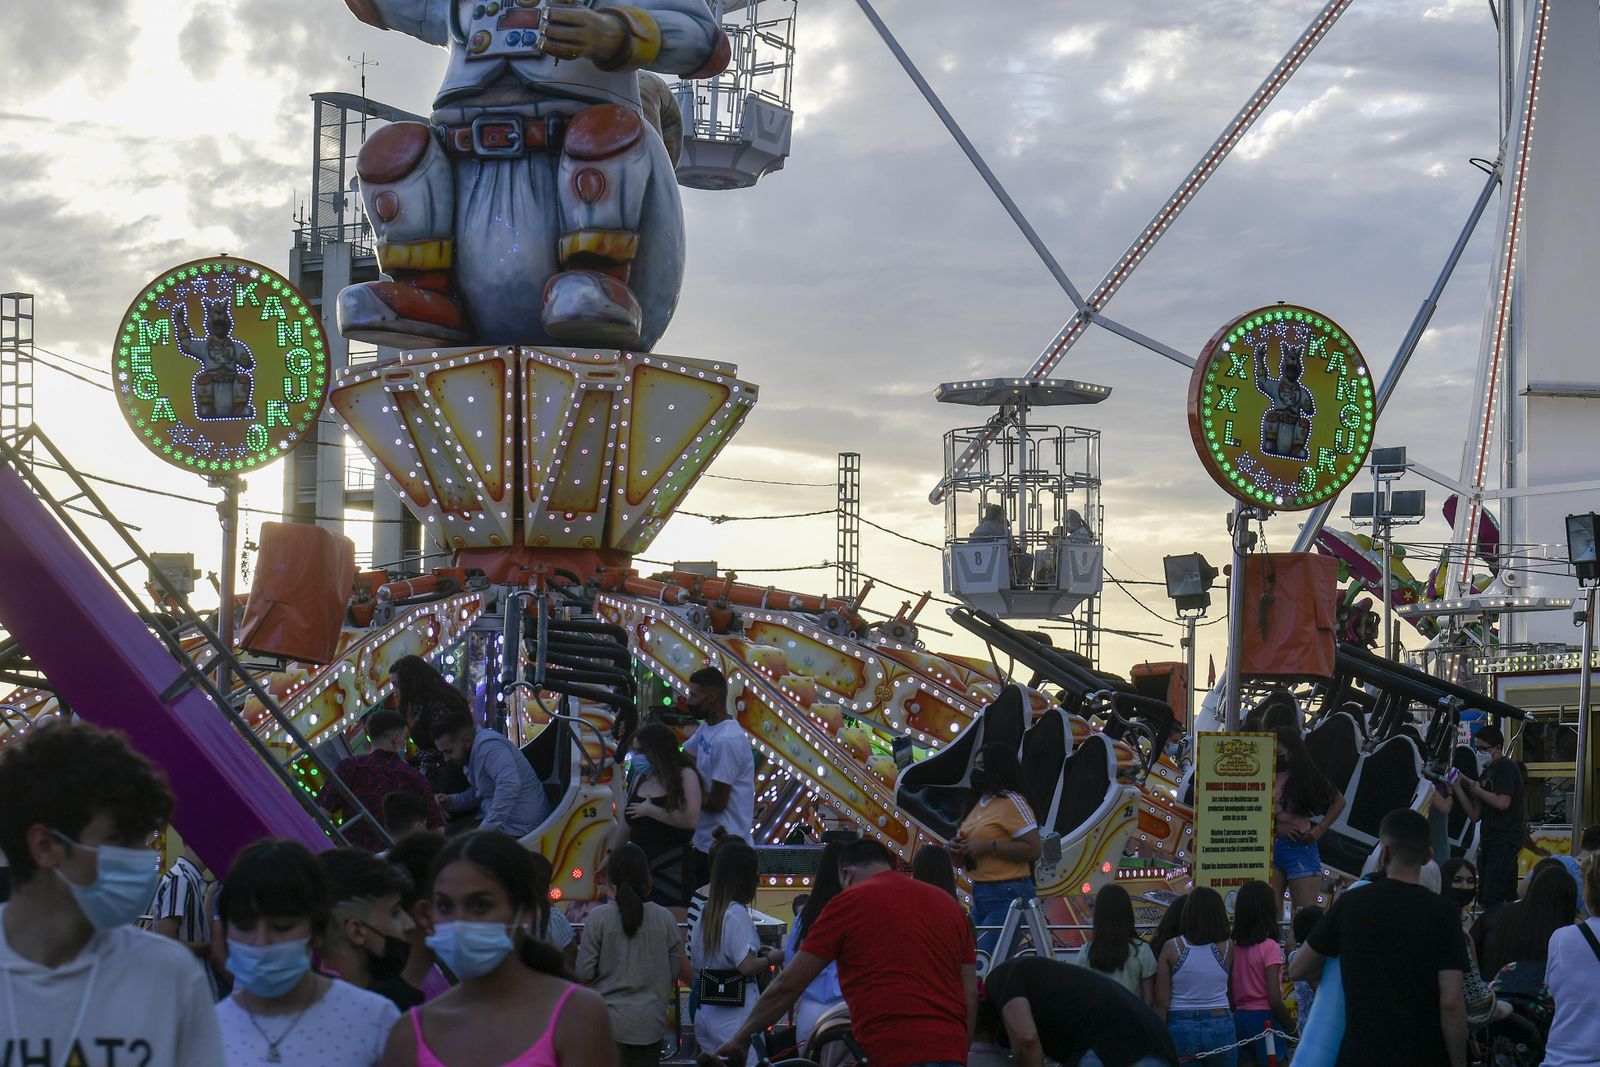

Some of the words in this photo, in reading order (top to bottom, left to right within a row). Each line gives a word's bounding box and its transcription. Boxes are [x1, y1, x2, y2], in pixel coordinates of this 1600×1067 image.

[130, 318, 177, 423] MEGA
[235, 281, 313, 453] KANGURO
[1214, 352, 1249, 447] XXL
[1298, 333, 1361, 493] KANGURO
[974, 551, 982, 566] 8
[1081, 551, 1088, 566] 8
